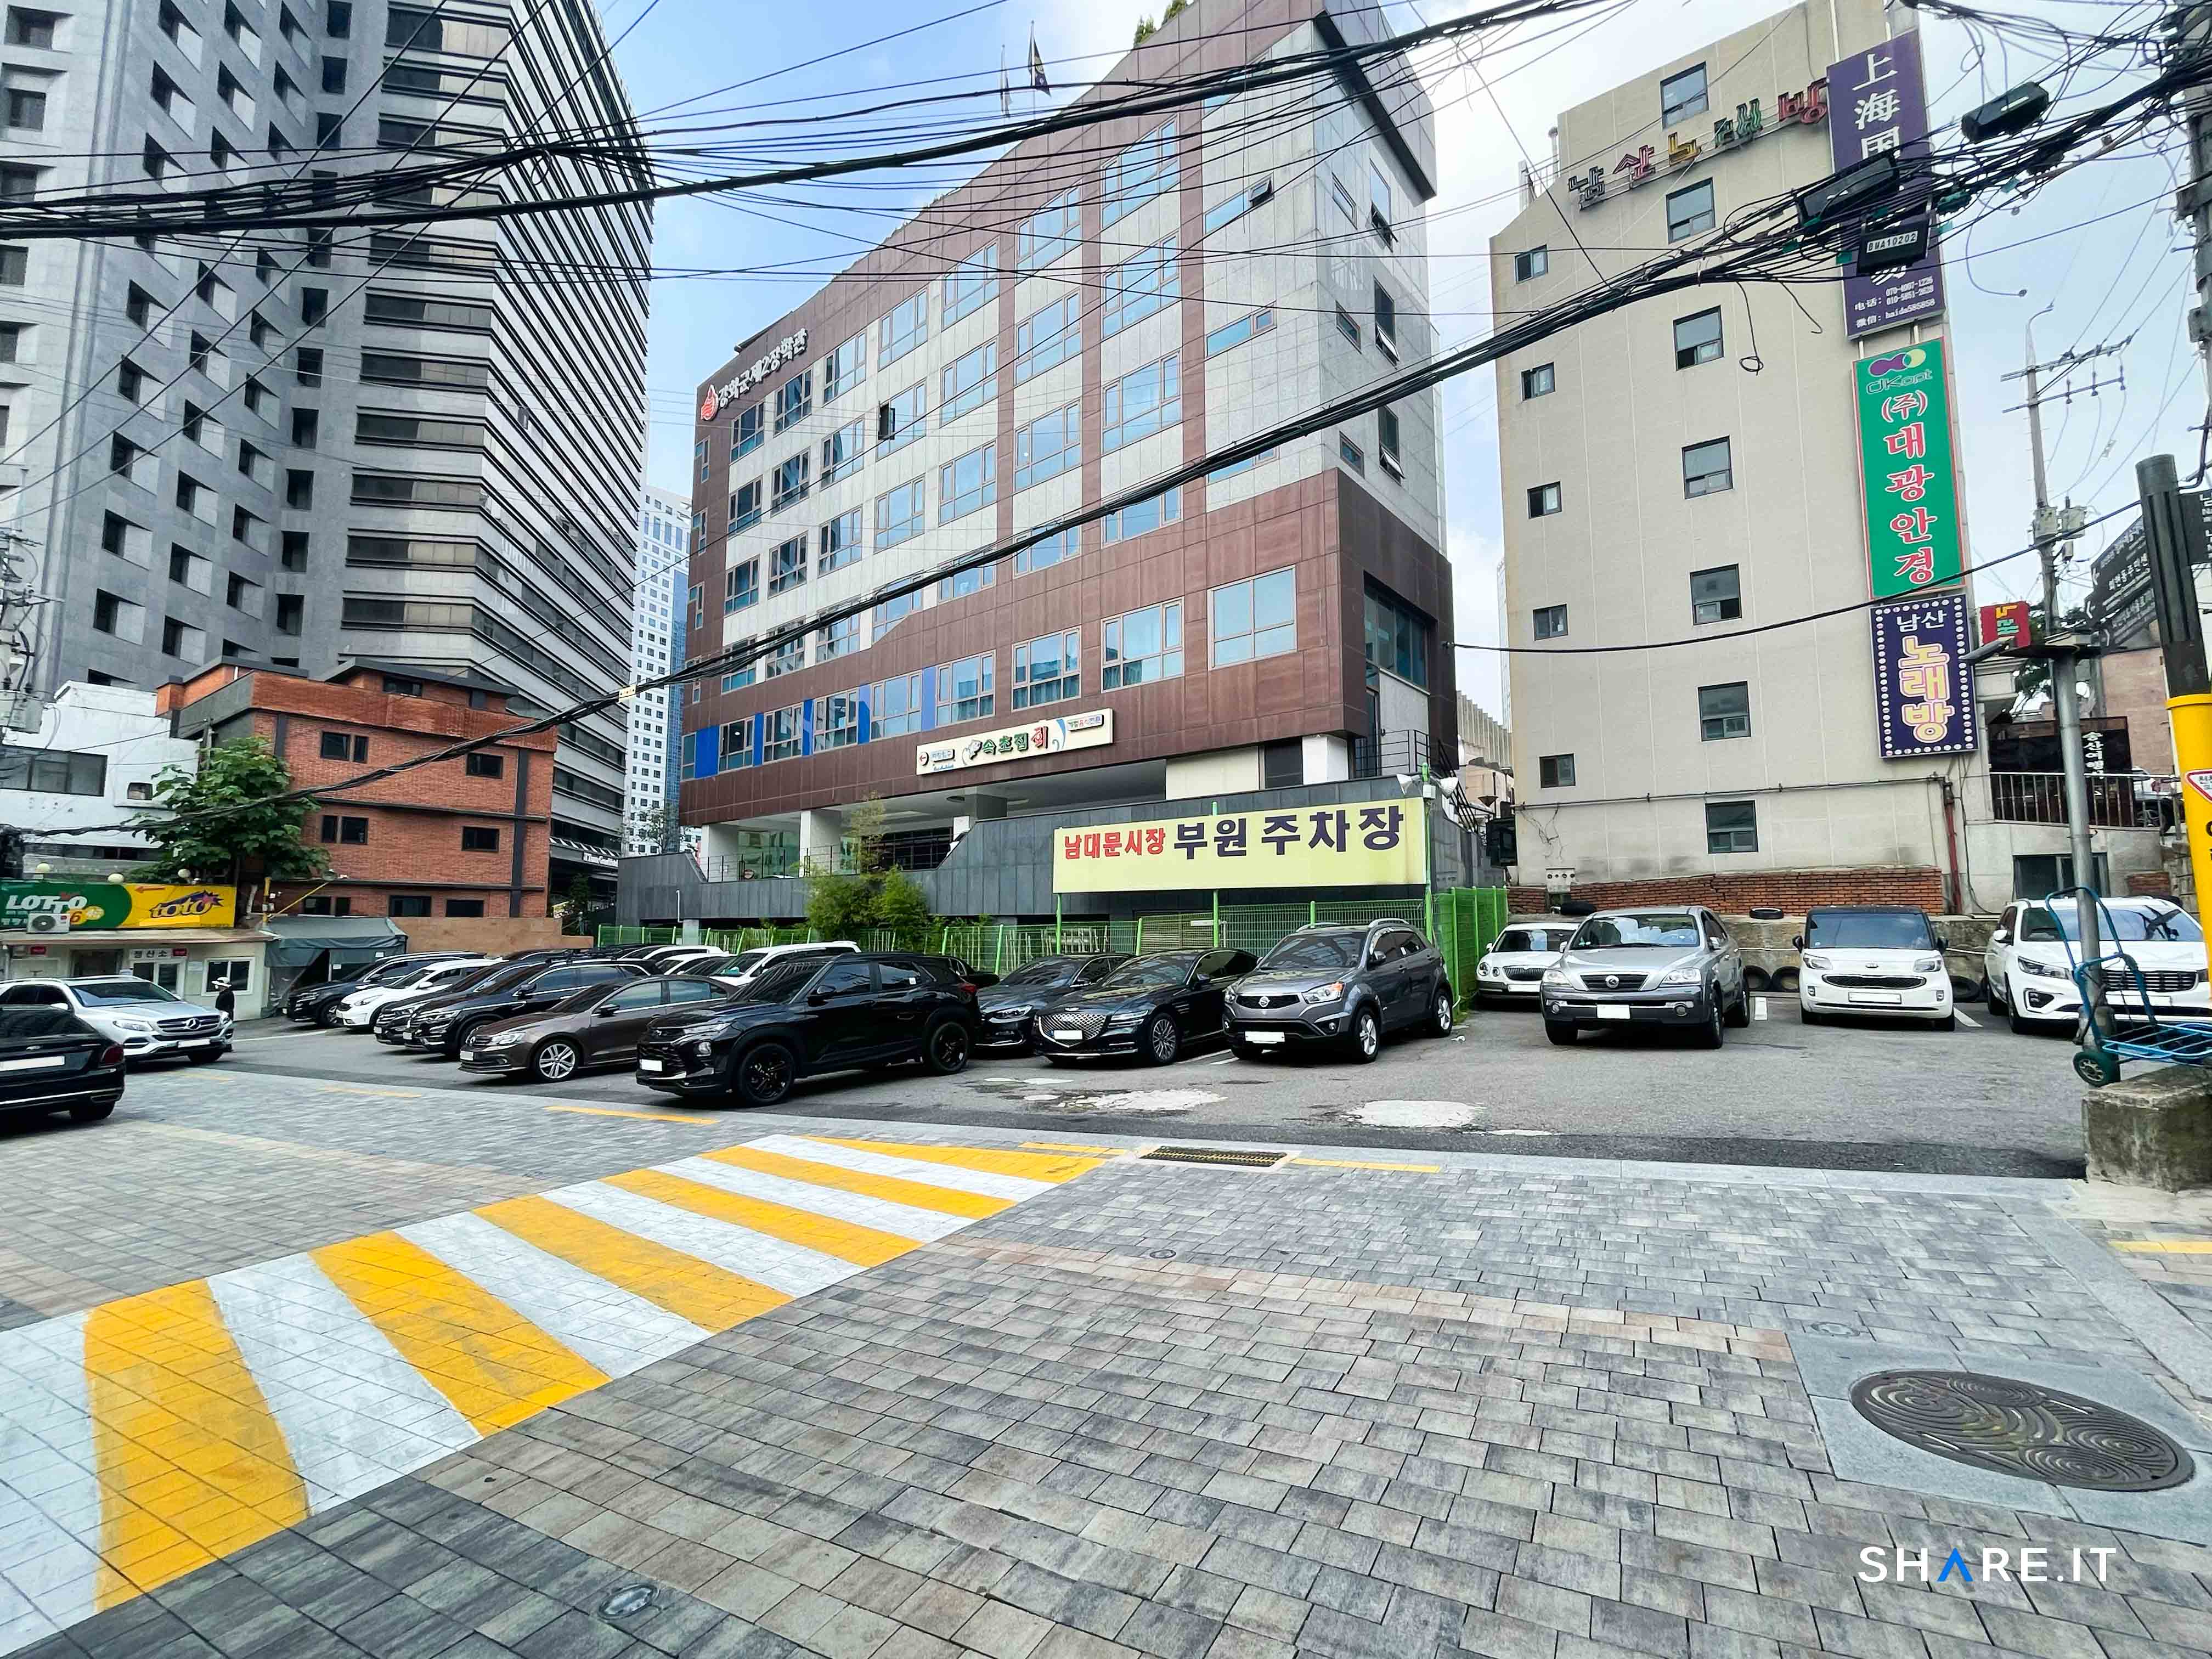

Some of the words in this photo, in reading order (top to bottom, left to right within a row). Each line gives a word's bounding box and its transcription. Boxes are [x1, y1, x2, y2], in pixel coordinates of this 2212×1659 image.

[1896, 610, 1947, 633] 남산
[1898, 635, 1955, 743] 노래방
[1064, 827, 1166, 859] 남대문시장
[5, 895, 88, 913] LOTTO
[150, 896, 212, 918] toto
